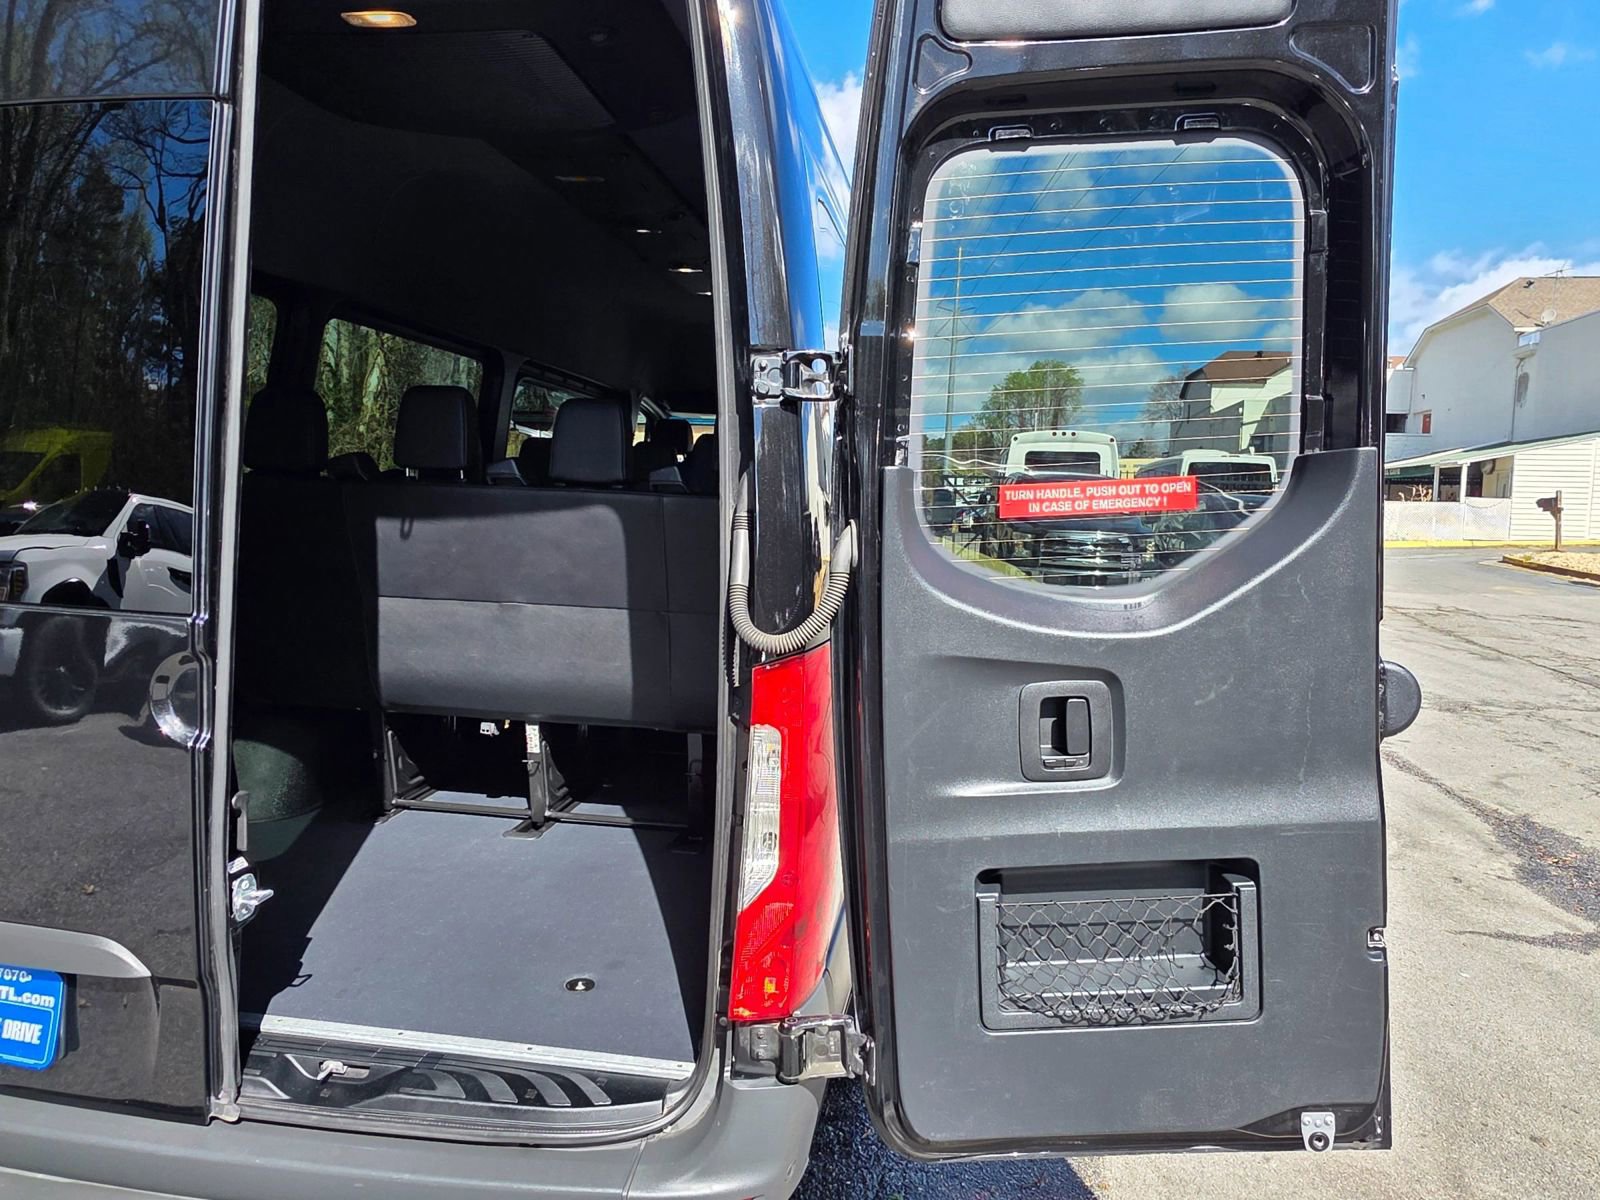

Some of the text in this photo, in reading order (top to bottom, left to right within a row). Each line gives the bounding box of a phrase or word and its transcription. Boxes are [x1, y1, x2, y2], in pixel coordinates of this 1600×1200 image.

[1005, 481, 1191, 500] TURN HANDLE, PUSH OUT TO OPEN
[1029, 502, 1040, 512] IN
[1042, 500, 1072, 512] CASE
[1074, 500, 1089, 510] OF
[1092, 497, 1161, 509] EMERGENCY
[2, 1019, 43, 1045] DRIVE
